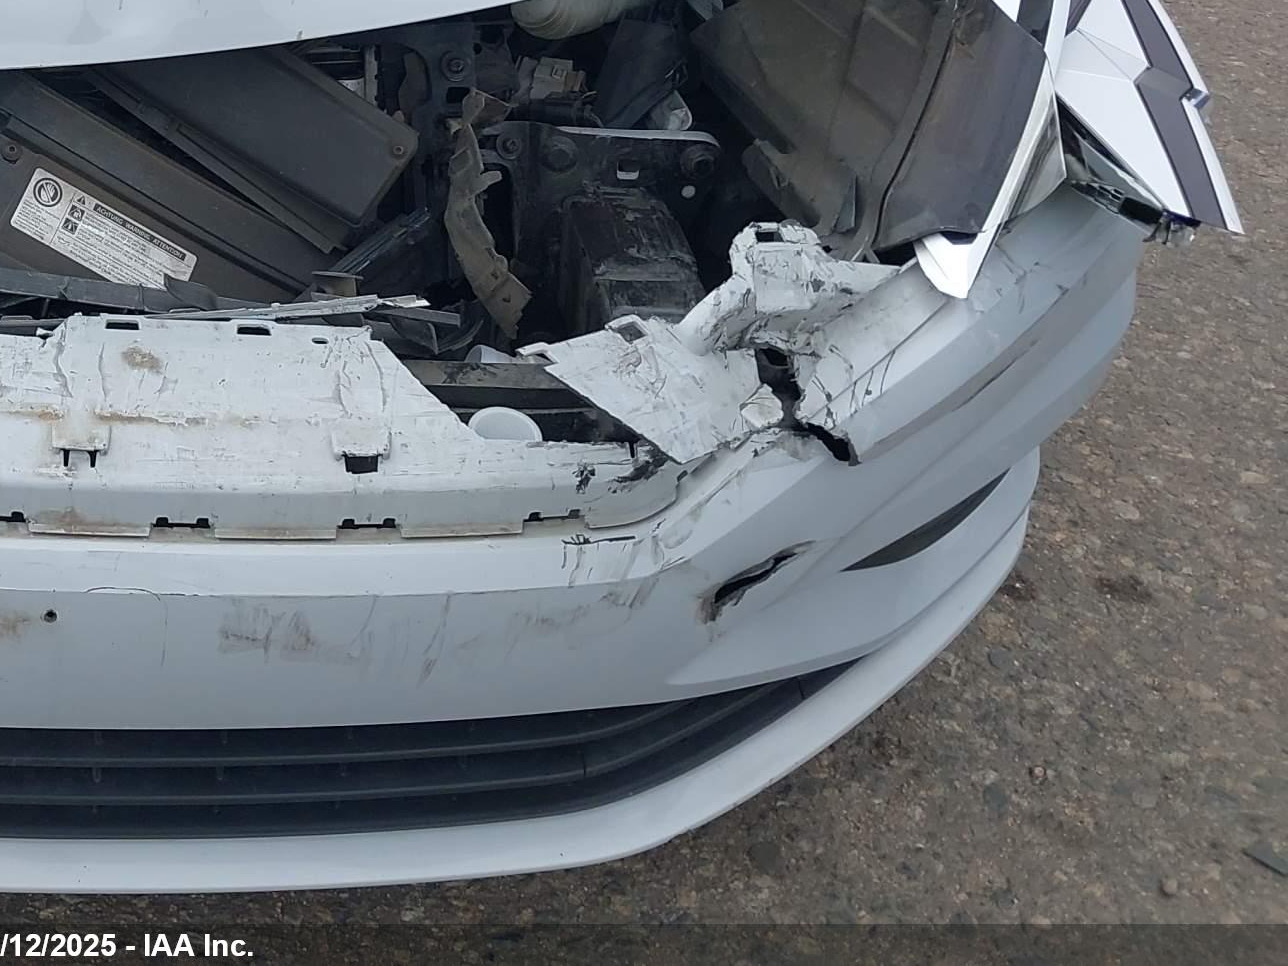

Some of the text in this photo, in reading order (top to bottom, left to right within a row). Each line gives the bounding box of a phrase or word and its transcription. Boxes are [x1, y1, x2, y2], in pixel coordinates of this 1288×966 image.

[96, 206, 124, 225] ACHTUNG
[125, 222, 151, 240] WARNING
[152, 238, 184, 259] ATTENTION
